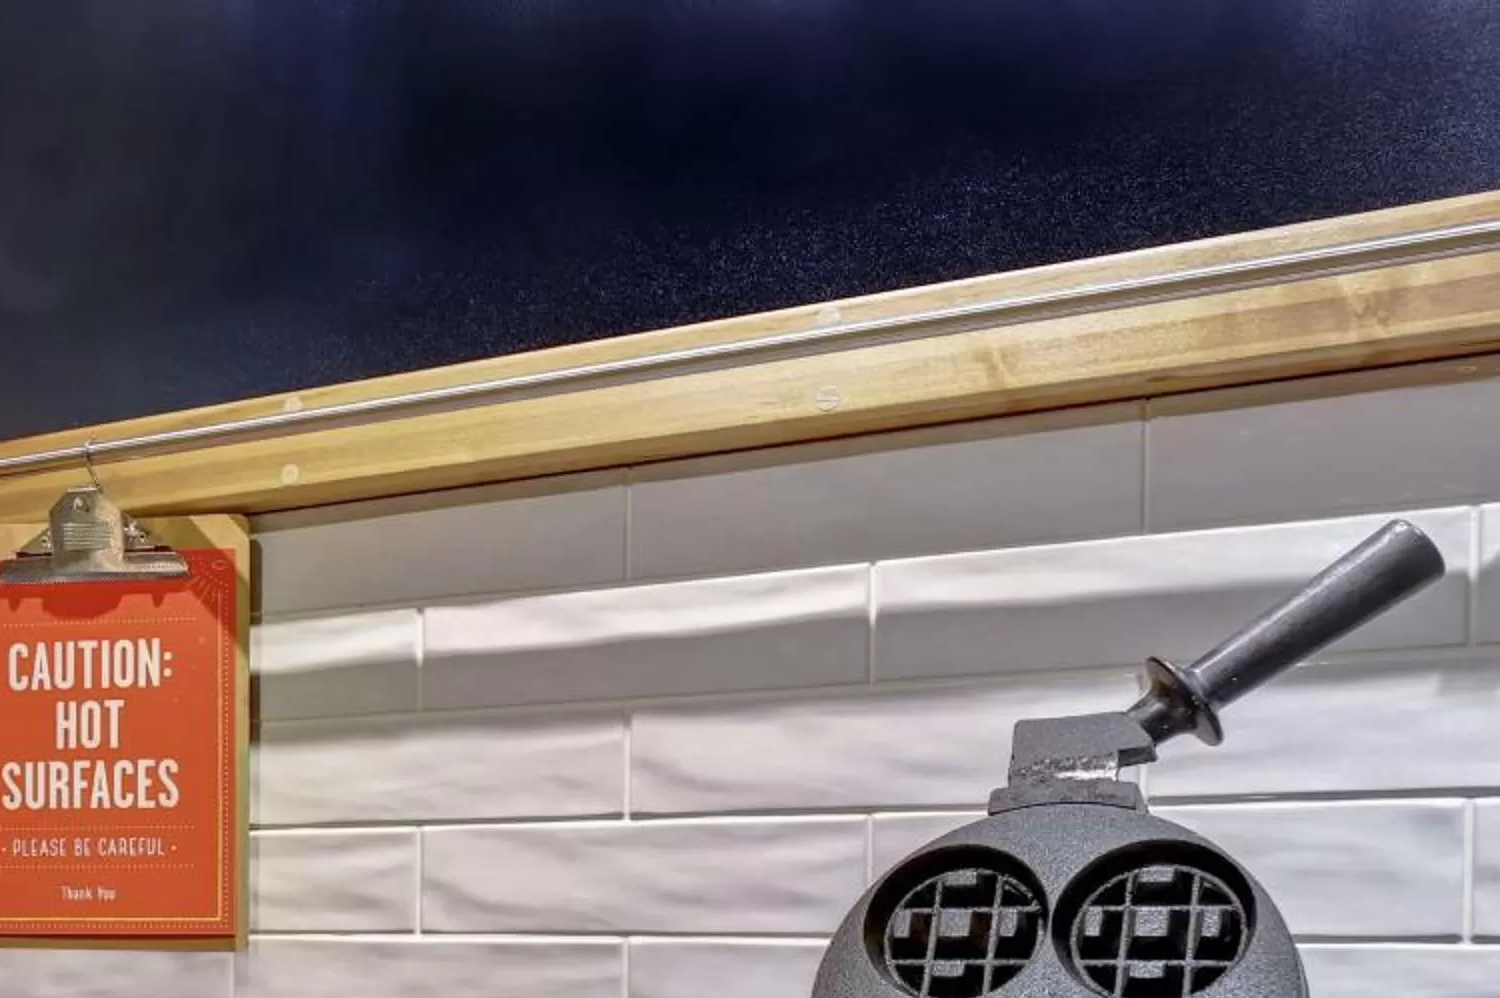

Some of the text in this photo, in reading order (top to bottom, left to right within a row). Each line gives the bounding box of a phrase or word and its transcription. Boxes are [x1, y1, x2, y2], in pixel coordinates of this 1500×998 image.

[7, 637, 174, 692] CAUTION:
[55, 699, 125, 750] HOT
[1, 759, 181, 811] SURFACES
[12, 837, 165, 857] PLEASE BE CAREFUL
[61, 885, 93, 901] Thank
